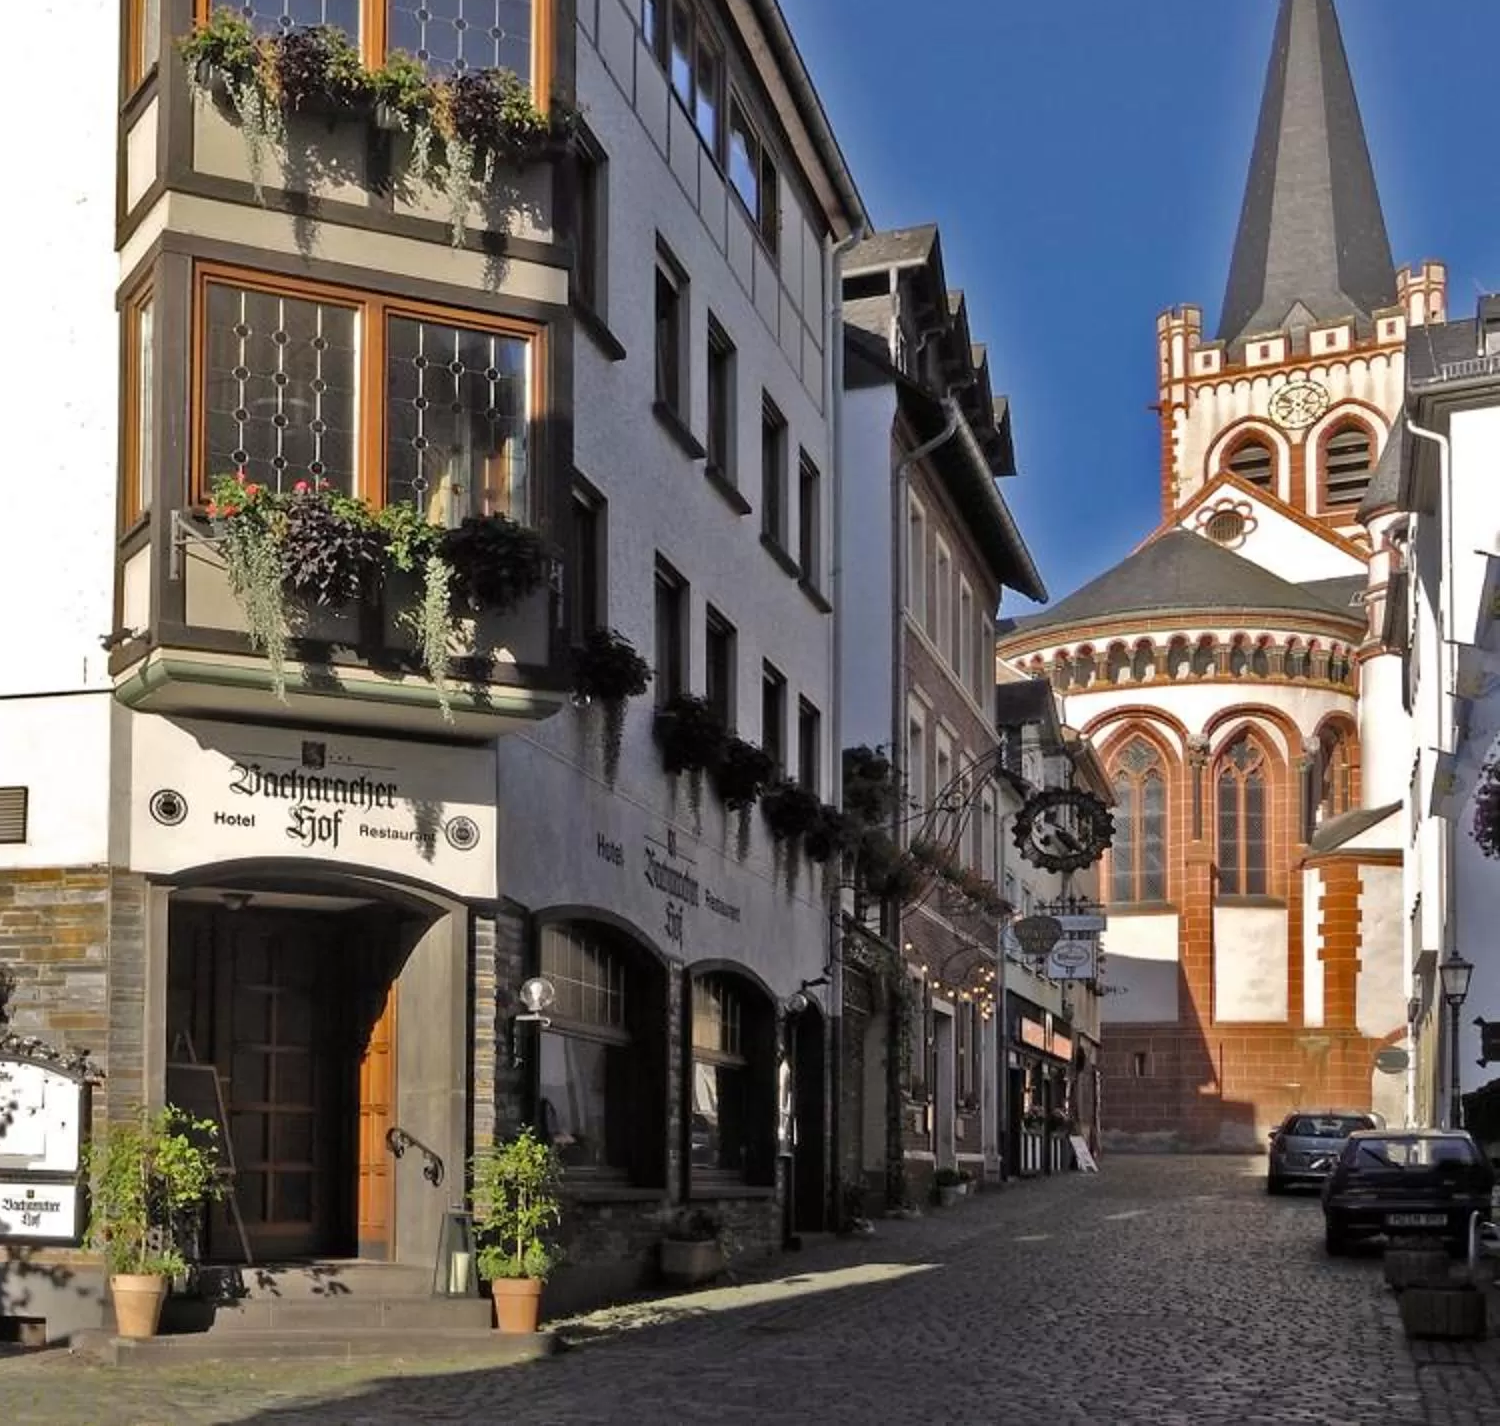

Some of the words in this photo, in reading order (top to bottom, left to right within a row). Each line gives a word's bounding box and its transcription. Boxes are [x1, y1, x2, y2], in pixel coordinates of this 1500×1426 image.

[228, 762, 398, 813] Bacharacher
[214, 811, 256, 827] Hotel
[285, 805, 344, 849] Hof
